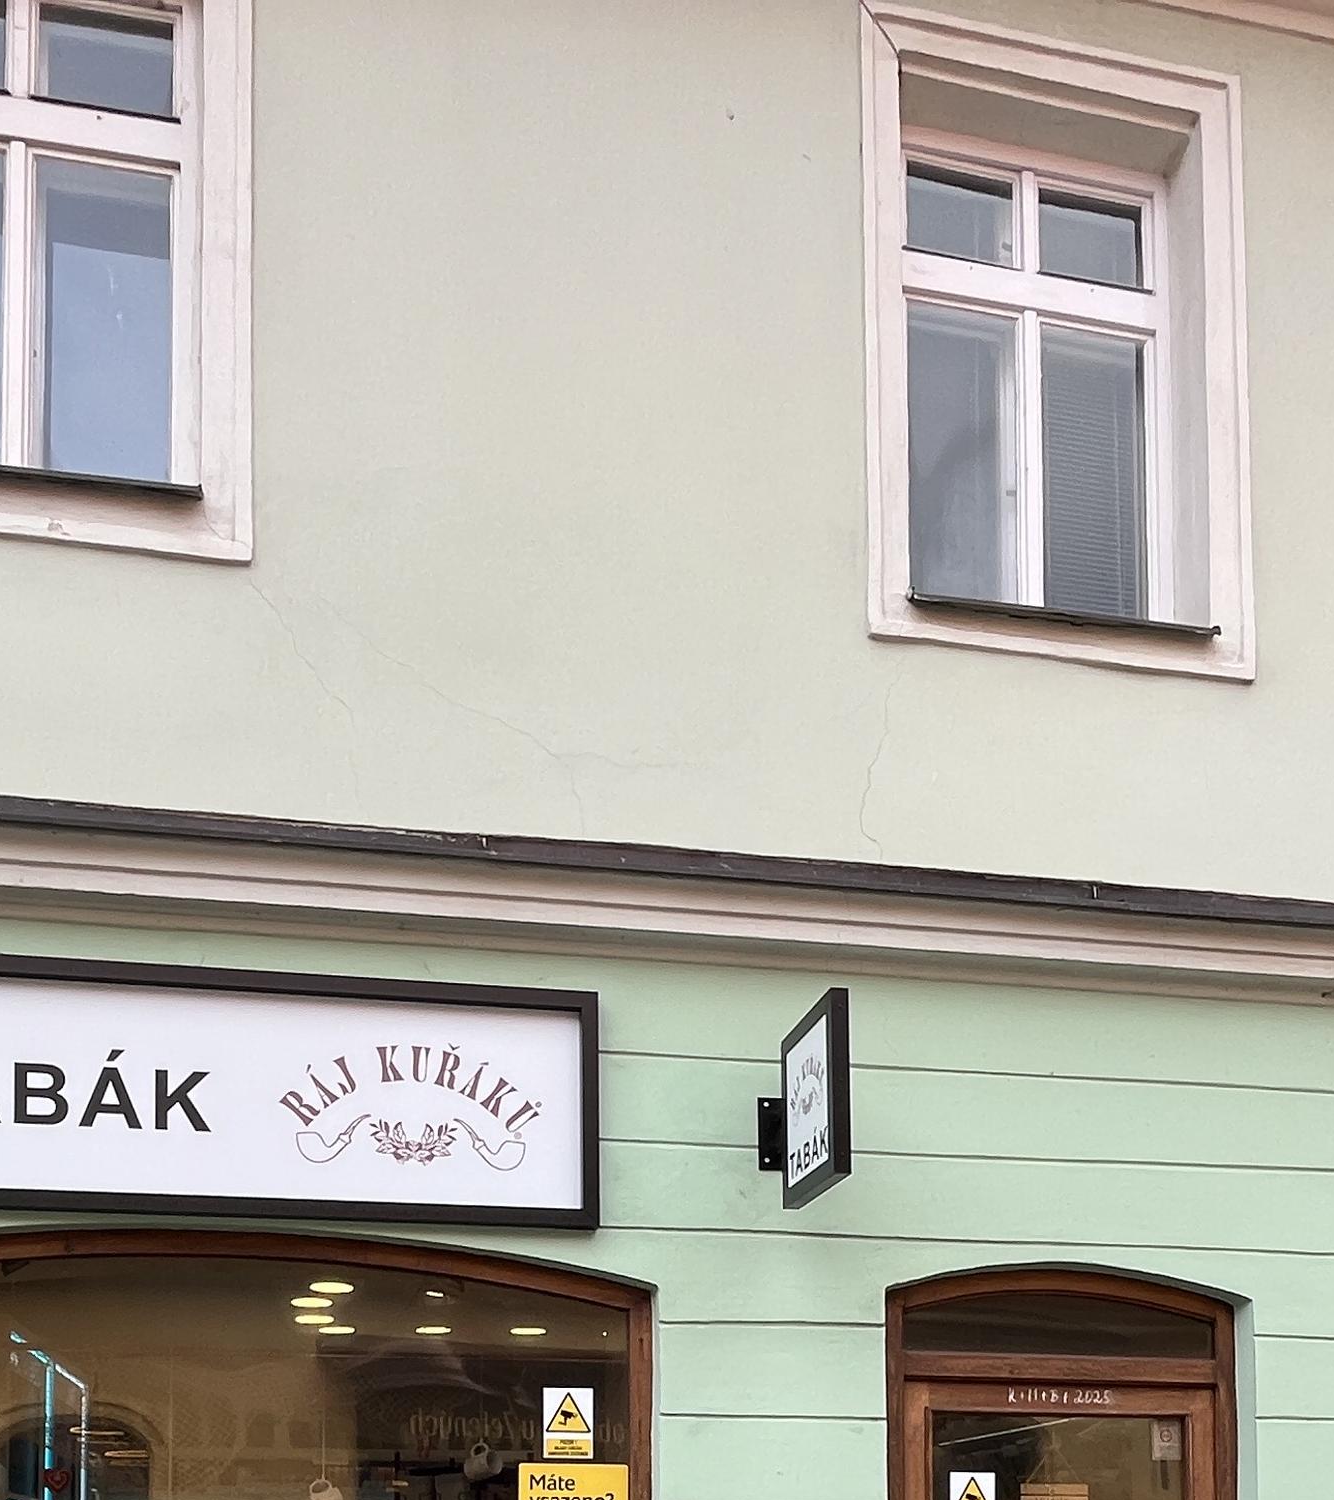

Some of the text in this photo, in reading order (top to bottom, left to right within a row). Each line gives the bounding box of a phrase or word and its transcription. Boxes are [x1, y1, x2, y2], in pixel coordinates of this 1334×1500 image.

[279, 1043, 543, 1134] RÁJ KUŘÁKŮ
[789, 1125, 829, 1179] TABÁK
[530, 1473, 576, 1491] Máte
